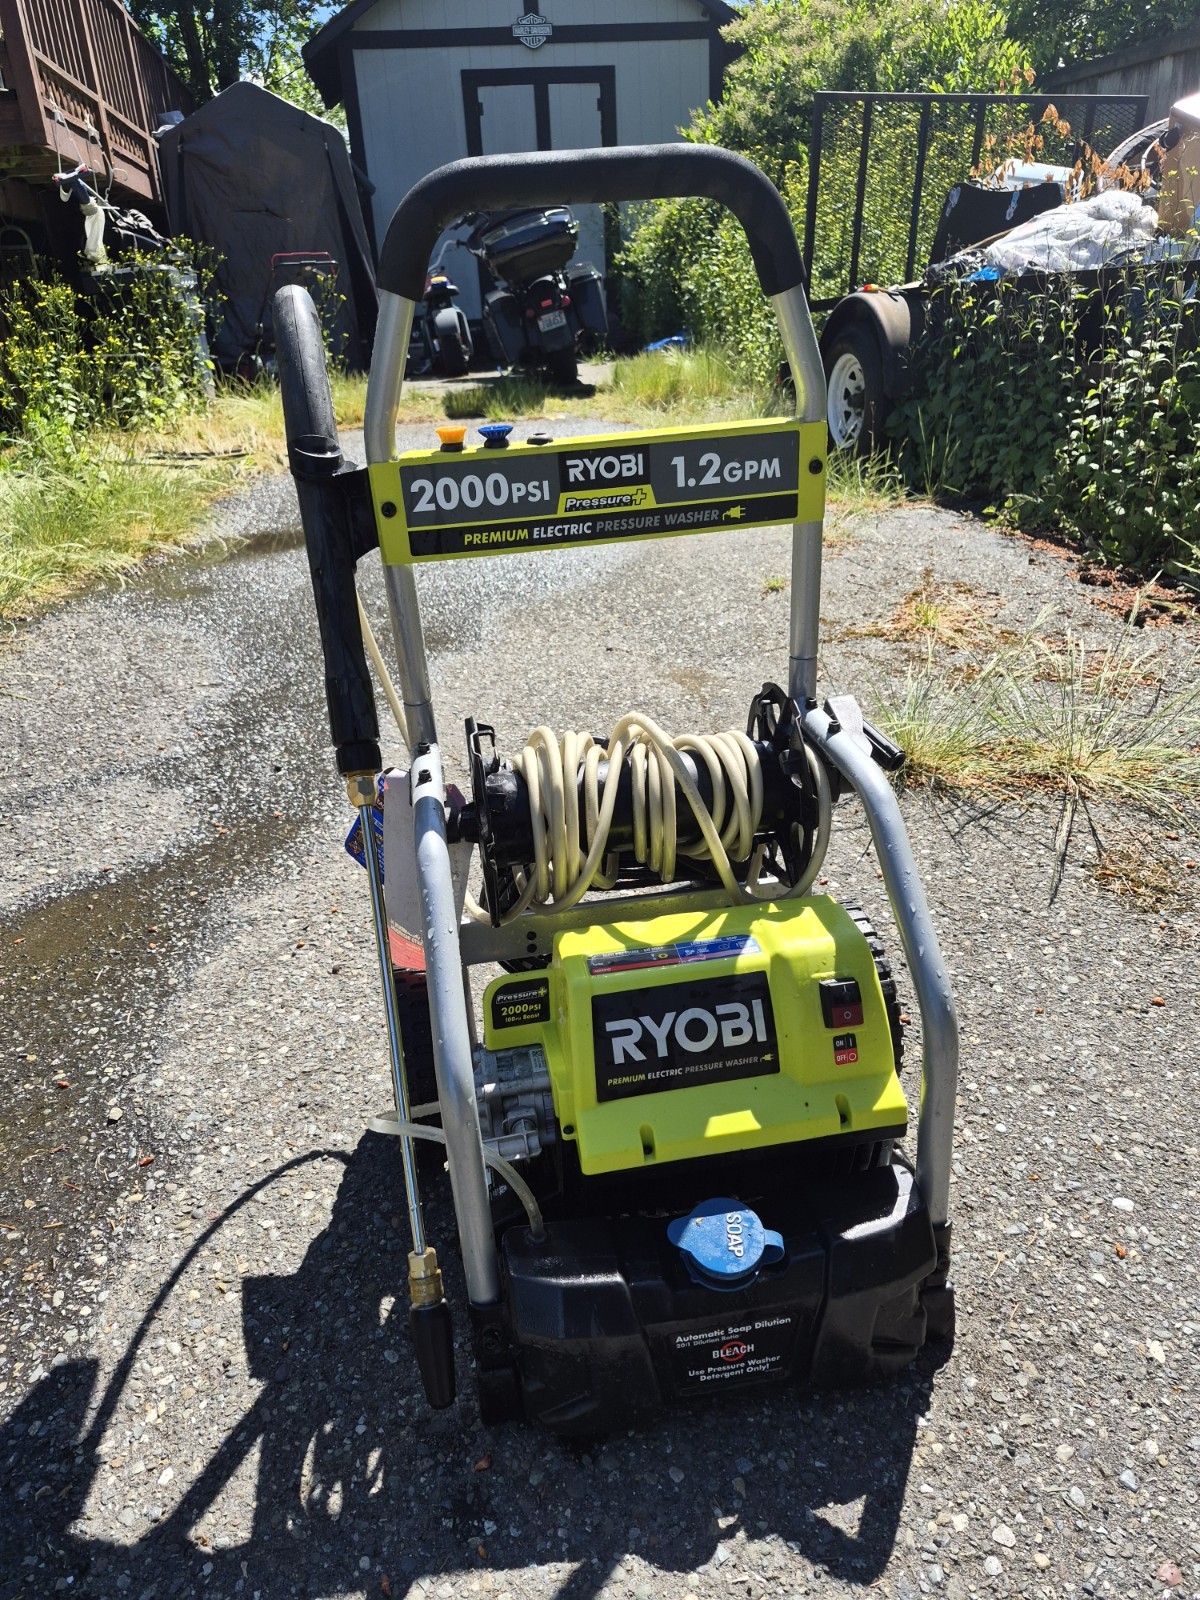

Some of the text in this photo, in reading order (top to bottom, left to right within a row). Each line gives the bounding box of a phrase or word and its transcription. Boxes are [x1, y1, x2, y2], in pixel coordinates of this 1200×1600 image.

[565, 453, 644, 483] RYOBI
[463, 509, 719, 546] PREMIUM ELECTRIC PRESSURE WASHER
[605, 999, 768, 1065] RYOBI
[607, 1055, 759, 1087] PREMIUM ELECTRIC PRESSURE WASHER
[836, 1054, 846, 1062] OFF
[726, 1212, 744, 1258] SOAP
[675, 1316, 792, 1344] Automatic Soap Dilution
[693, 1336, 720, 1347] Dilution
[721, 1333, 740, 1342] Ratio
[712, 1343, 755, 1359] BLEACH
[688, 1354, 781, 1377] Use Pressure Washer
[700, 1363, 770, 1382] Detergent Only!
